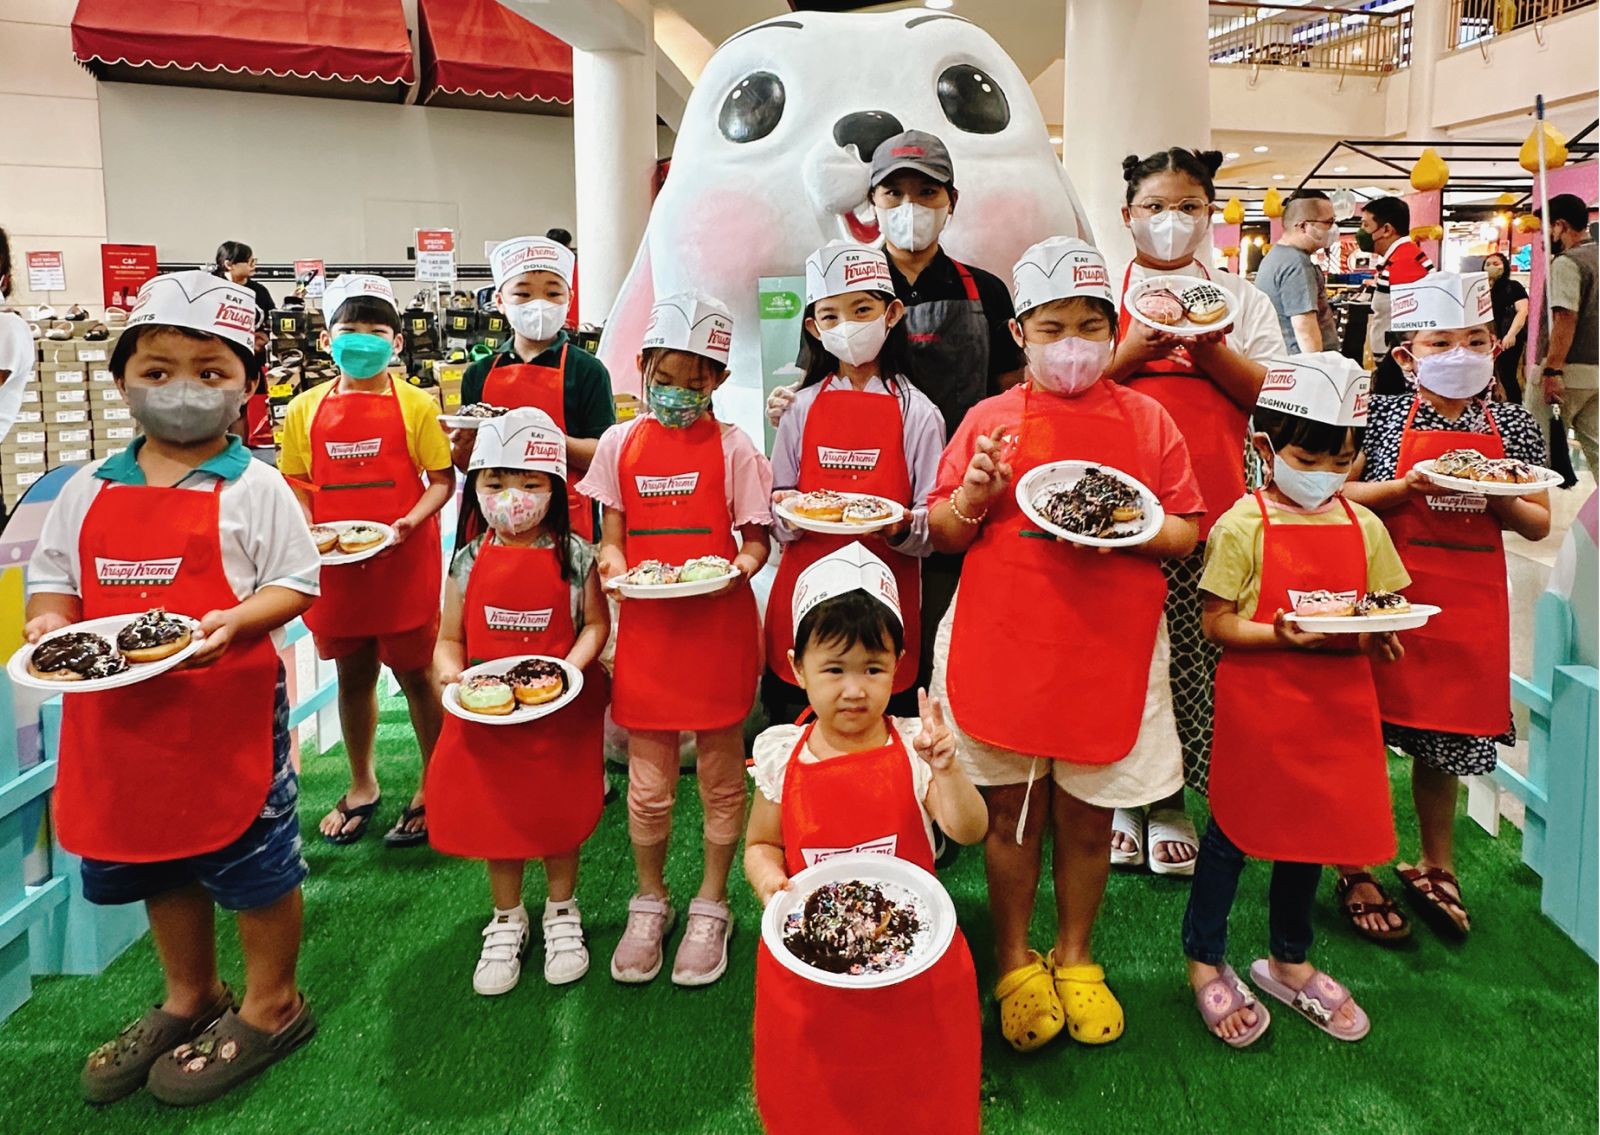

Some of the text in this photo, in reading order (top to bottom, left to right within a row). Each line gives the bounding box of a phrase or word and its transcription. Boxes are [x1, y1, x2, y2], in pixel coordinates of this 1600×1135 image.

[226, 293, 244, 304] EAT
[100, 562, 177, 578] Krispy Kreme
